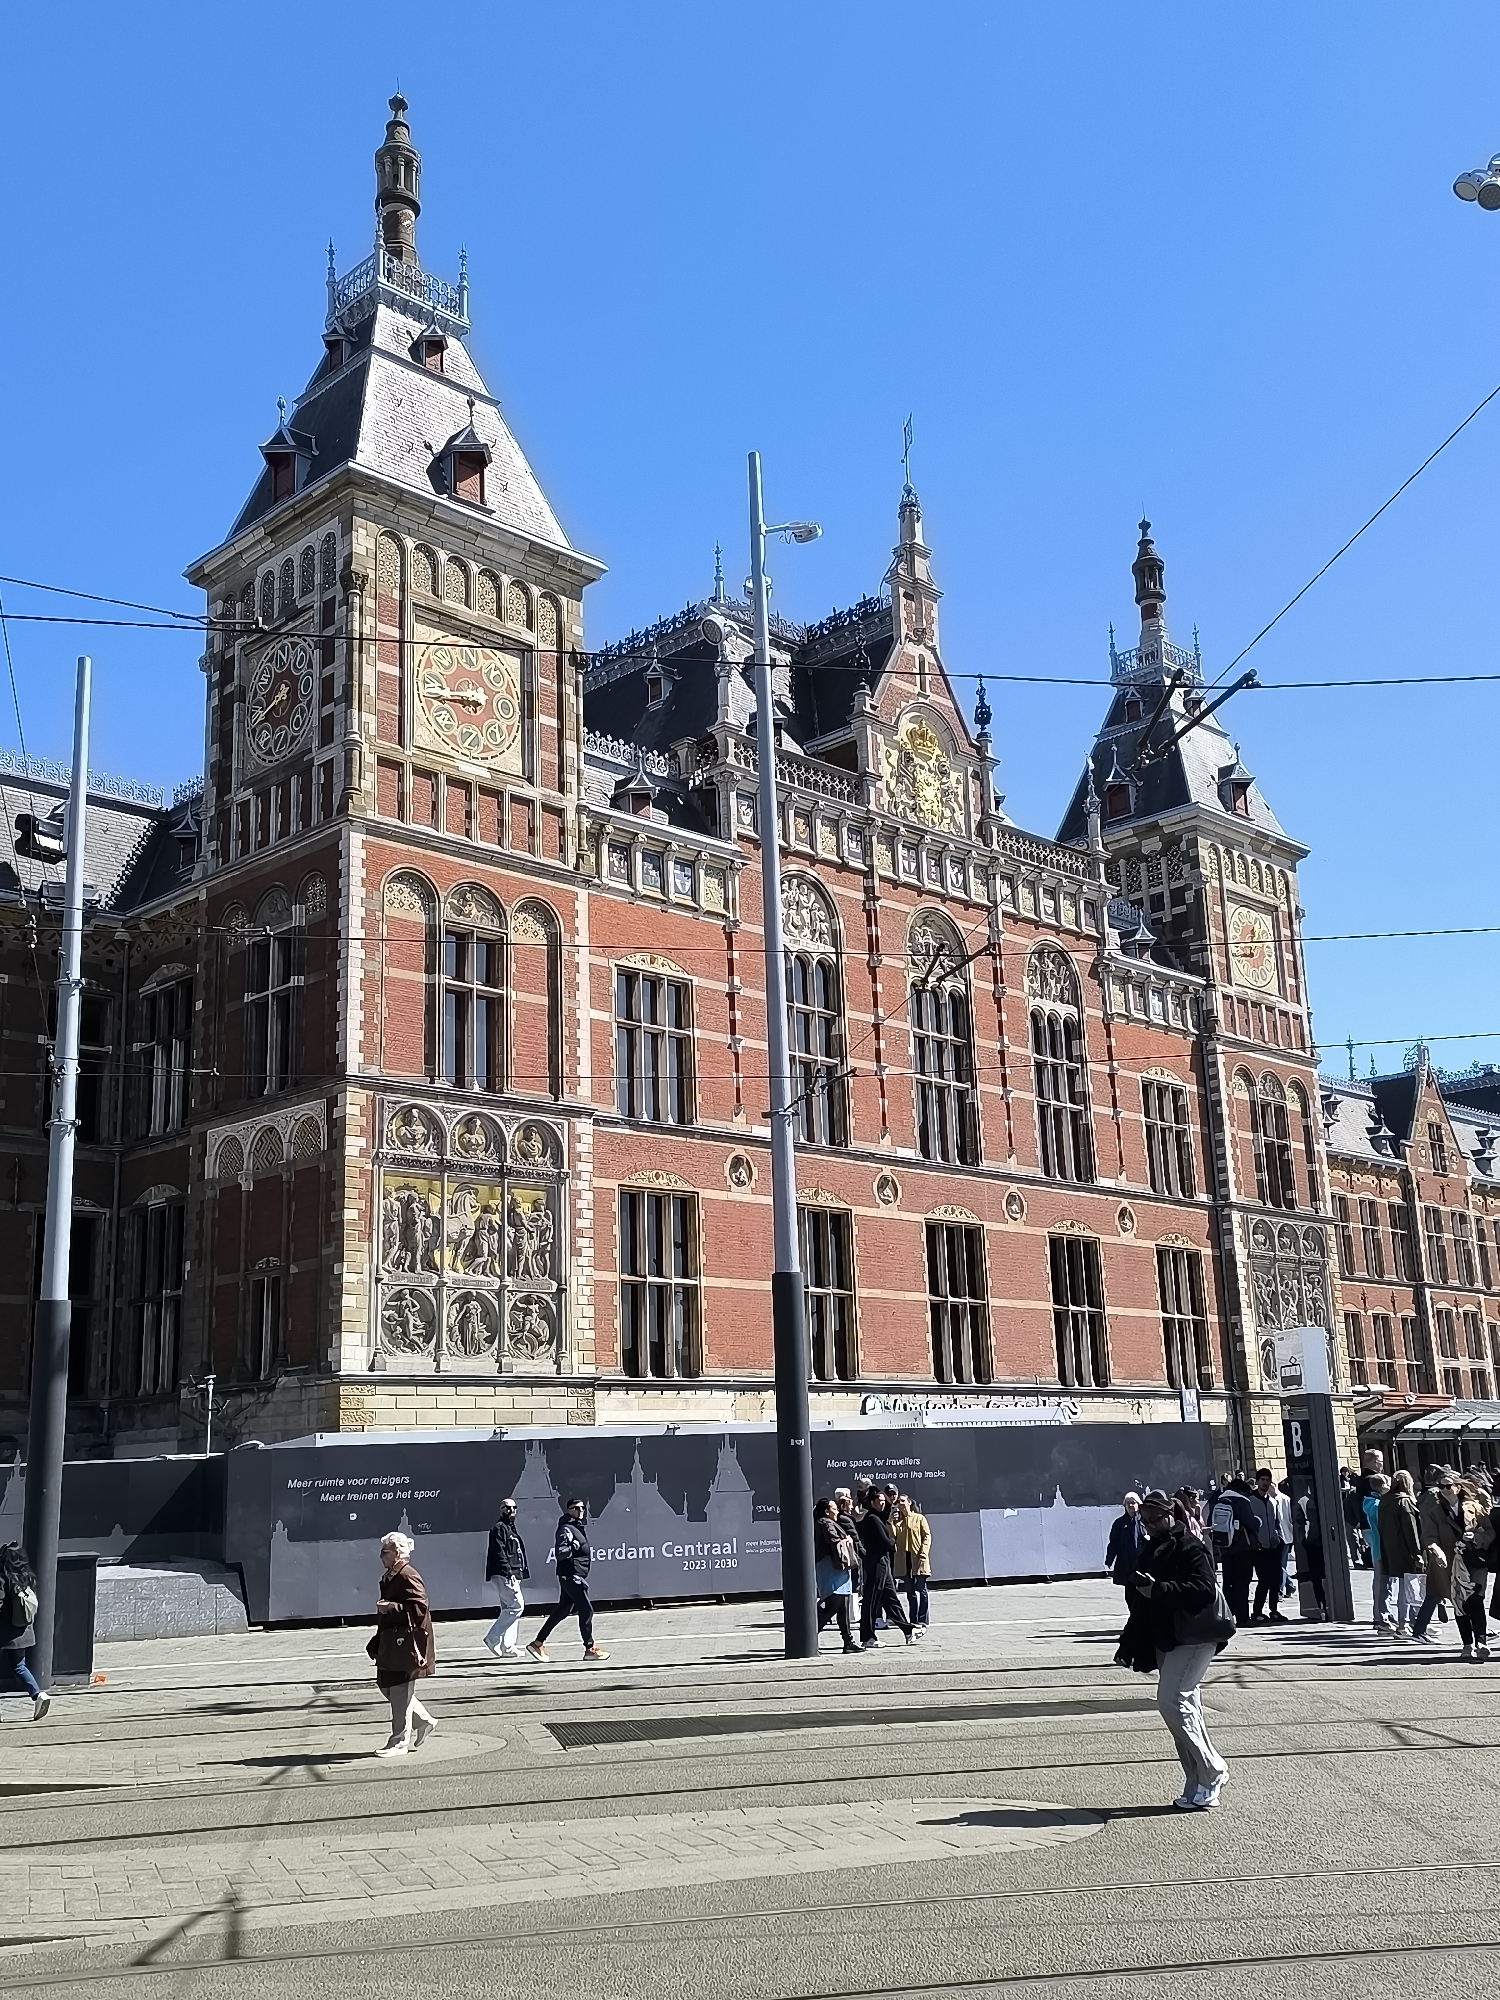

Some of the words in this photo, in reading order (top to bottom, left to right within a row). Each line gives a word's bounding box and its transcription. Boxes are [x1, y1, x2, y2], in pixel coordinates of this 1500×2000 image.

[1291, 1421, 1304, 1457] B
[826, 1459, 847, 1468] More
[849, 1459, 872, 1469] space
[873, 1457, 885, 1467] for
[886, 1457, 921, 1466] travellers
[854, 1472, 875, 1480] More
[876, 1471, 897, 1480] trains
[898, 1471, 909, 1479] on
[910, 1470, 922, 1479] the
[924, 1469, 946, 1478] tracks
[287, 1478, 313, 1489] Meer
[314, 1477, 345, 1488] ruimte
[347, 1478, 369, 1486] voor
[370, 1475, 410, 1487] reizigers
[320, 1493, 345, 1502] Meer
[347, 1492, 379, 1501] treinen
[381, 1492, 394, 1501] op
[395, 1489, 411, 1499] het
[413, 1489, 441, 1500] spoor
[545, 1542, 654, 1564] Aterdam
[661, 1537, 737, 1558] Centraal
[682, 1560, 707, 1571] 2023
[714, 1558, 738, 1569] 2030
